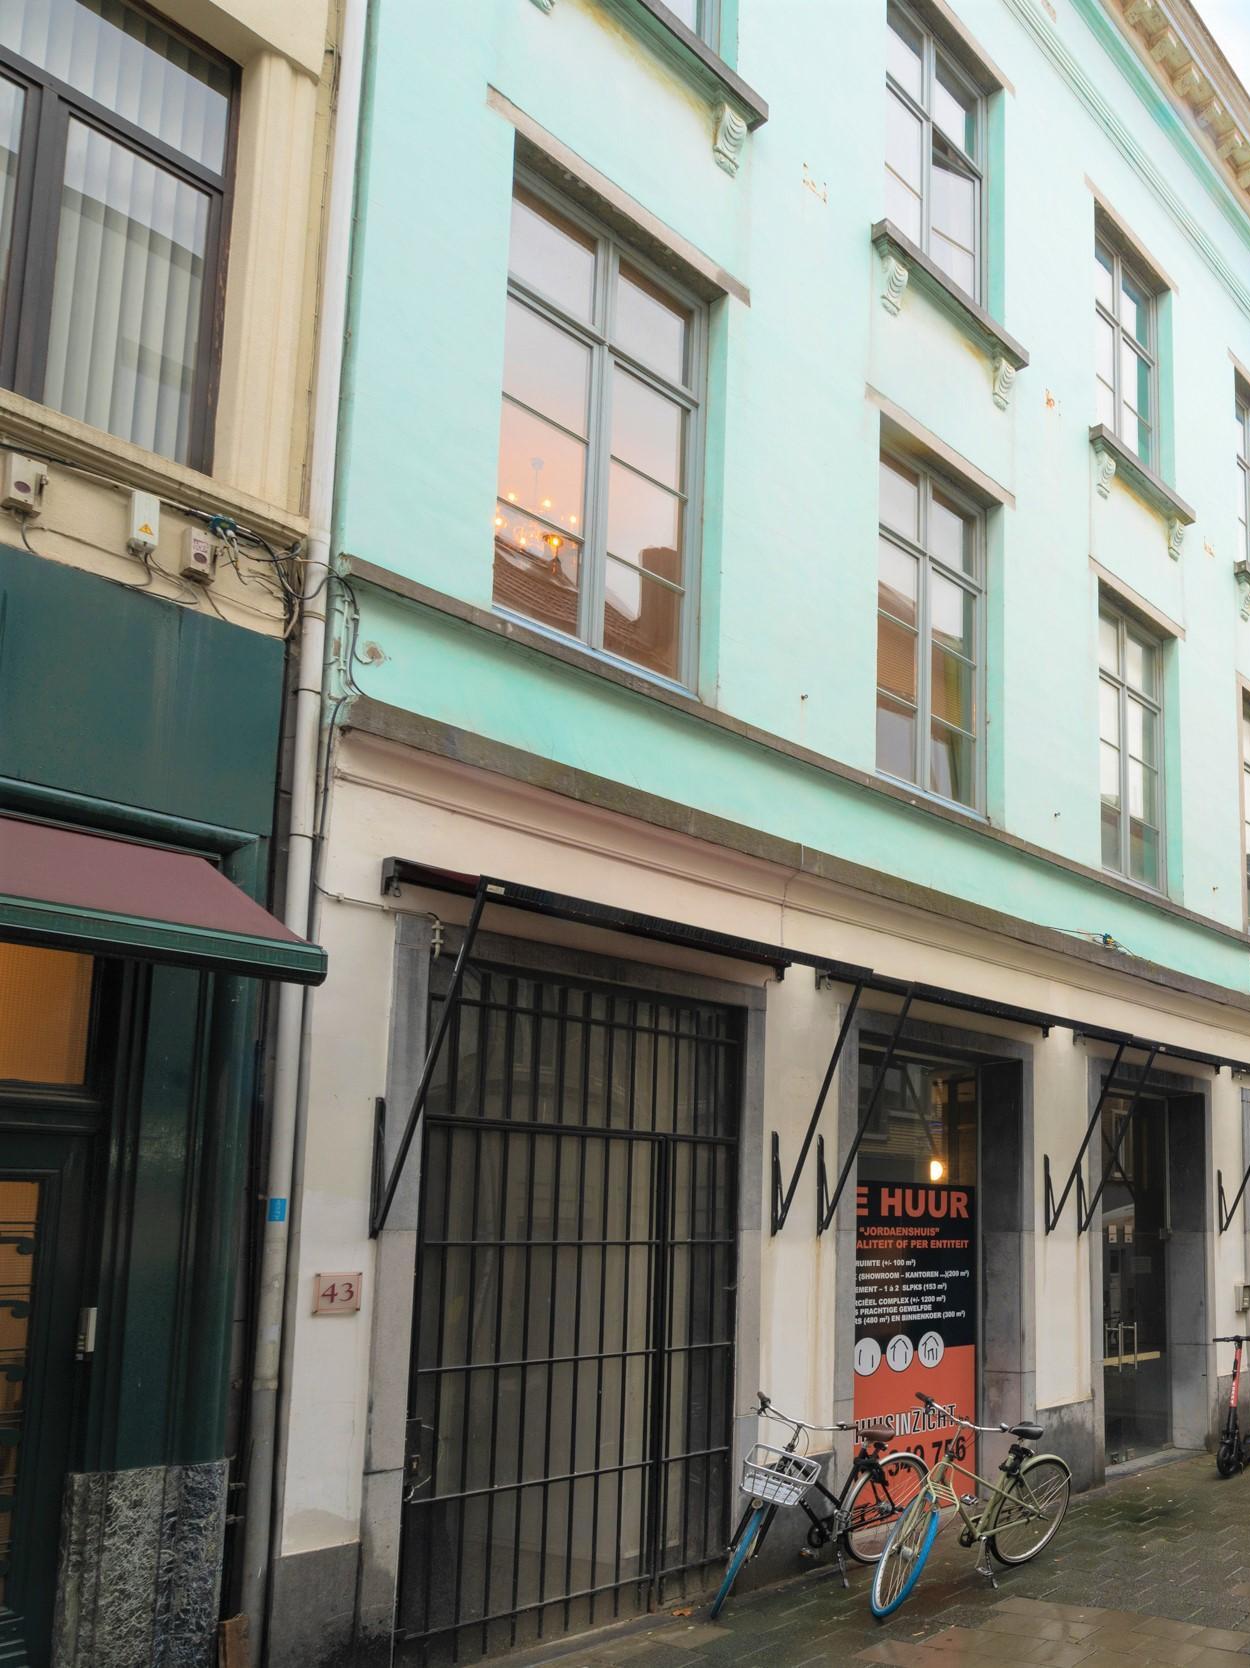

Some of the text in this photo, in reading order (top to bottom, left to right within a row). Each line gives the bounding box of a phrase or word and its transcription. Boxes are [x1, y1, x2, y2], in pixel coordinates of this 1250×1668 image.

[880, 1187, 969, 1219] HUUR
[896, 1240, 909, 1249] OF
[910, 1240, 929, 1249] PER
[930, 1240, 969, 1249] ENTITEIT
[320, 1282, 355, 1304] 43
[891, 1314, 901, 1322] EN
